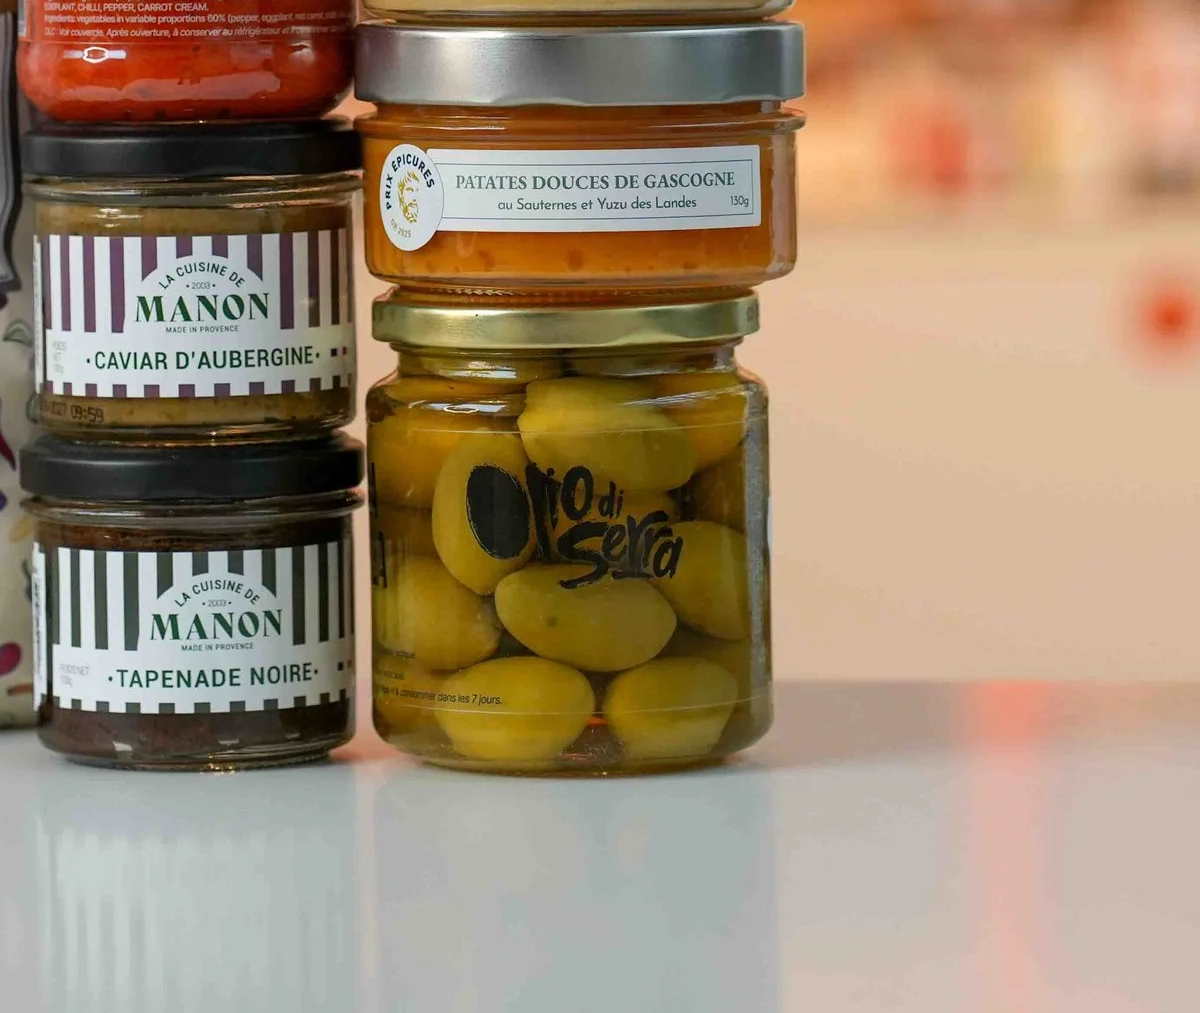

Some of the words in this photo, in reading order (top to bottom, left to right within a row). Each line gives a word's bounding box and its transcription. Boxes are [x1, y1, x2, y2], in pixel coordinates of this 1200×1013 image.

[103, 3, 136, 12] PEPPER,
[137, 3, 173, 12] CARROT
[174, 2, 209, 11] CREAM.
[385, 174, 394, 210] PRIX
[455, 174, 527, 190] PATATES
[532, 174, 610, 191] DOUCES
[614, 174, 640, 189] DE
[643, 171, 736, 189] GASCOGNE
[497, 201, 513, 211] au
[516, 197, 577, 211] Sauternes
[580, 198, 593, 210] et
[596, 197, 627, 211] Yuzu
[631, 196, 652, 210] des
[655, 196, 697, 210] Landes
[730, 195, 750, 209] 130g
[159, 274, 176, 290] LA
[176, 261, 228, 277] CUISINE
[229, 271, 246, 288] DE
[135, 292, 270, 323] MANON
[165, 326, 187, 334] MADE
[199, 325, 239, 334] PROVENCE
[94, 351, 168, 370] CAVIAR
[176, 345, 314, 370] D'AUBERGINE
[598, 481, 624, 519] di
[174, 592, 192, 608] LA
[192, 579, 245, 595] CUISINE
[244, 588, 261, 605] DE
[150, 609, 283, 641] MANON
[181, 644, 203, 652] MADE
[205, 643, 213, 651] IN
[215, 642, 254, 651] PROVENCE
[116, 668, 241, 689] TAPENADE
[250, 662, 313, 685] NOIRE
[437, 692, 456, 703] dans
[458, 694, 470, 704] les
[471, 694, 478, 704] 7
[478, 694, 503, 706] jours.
